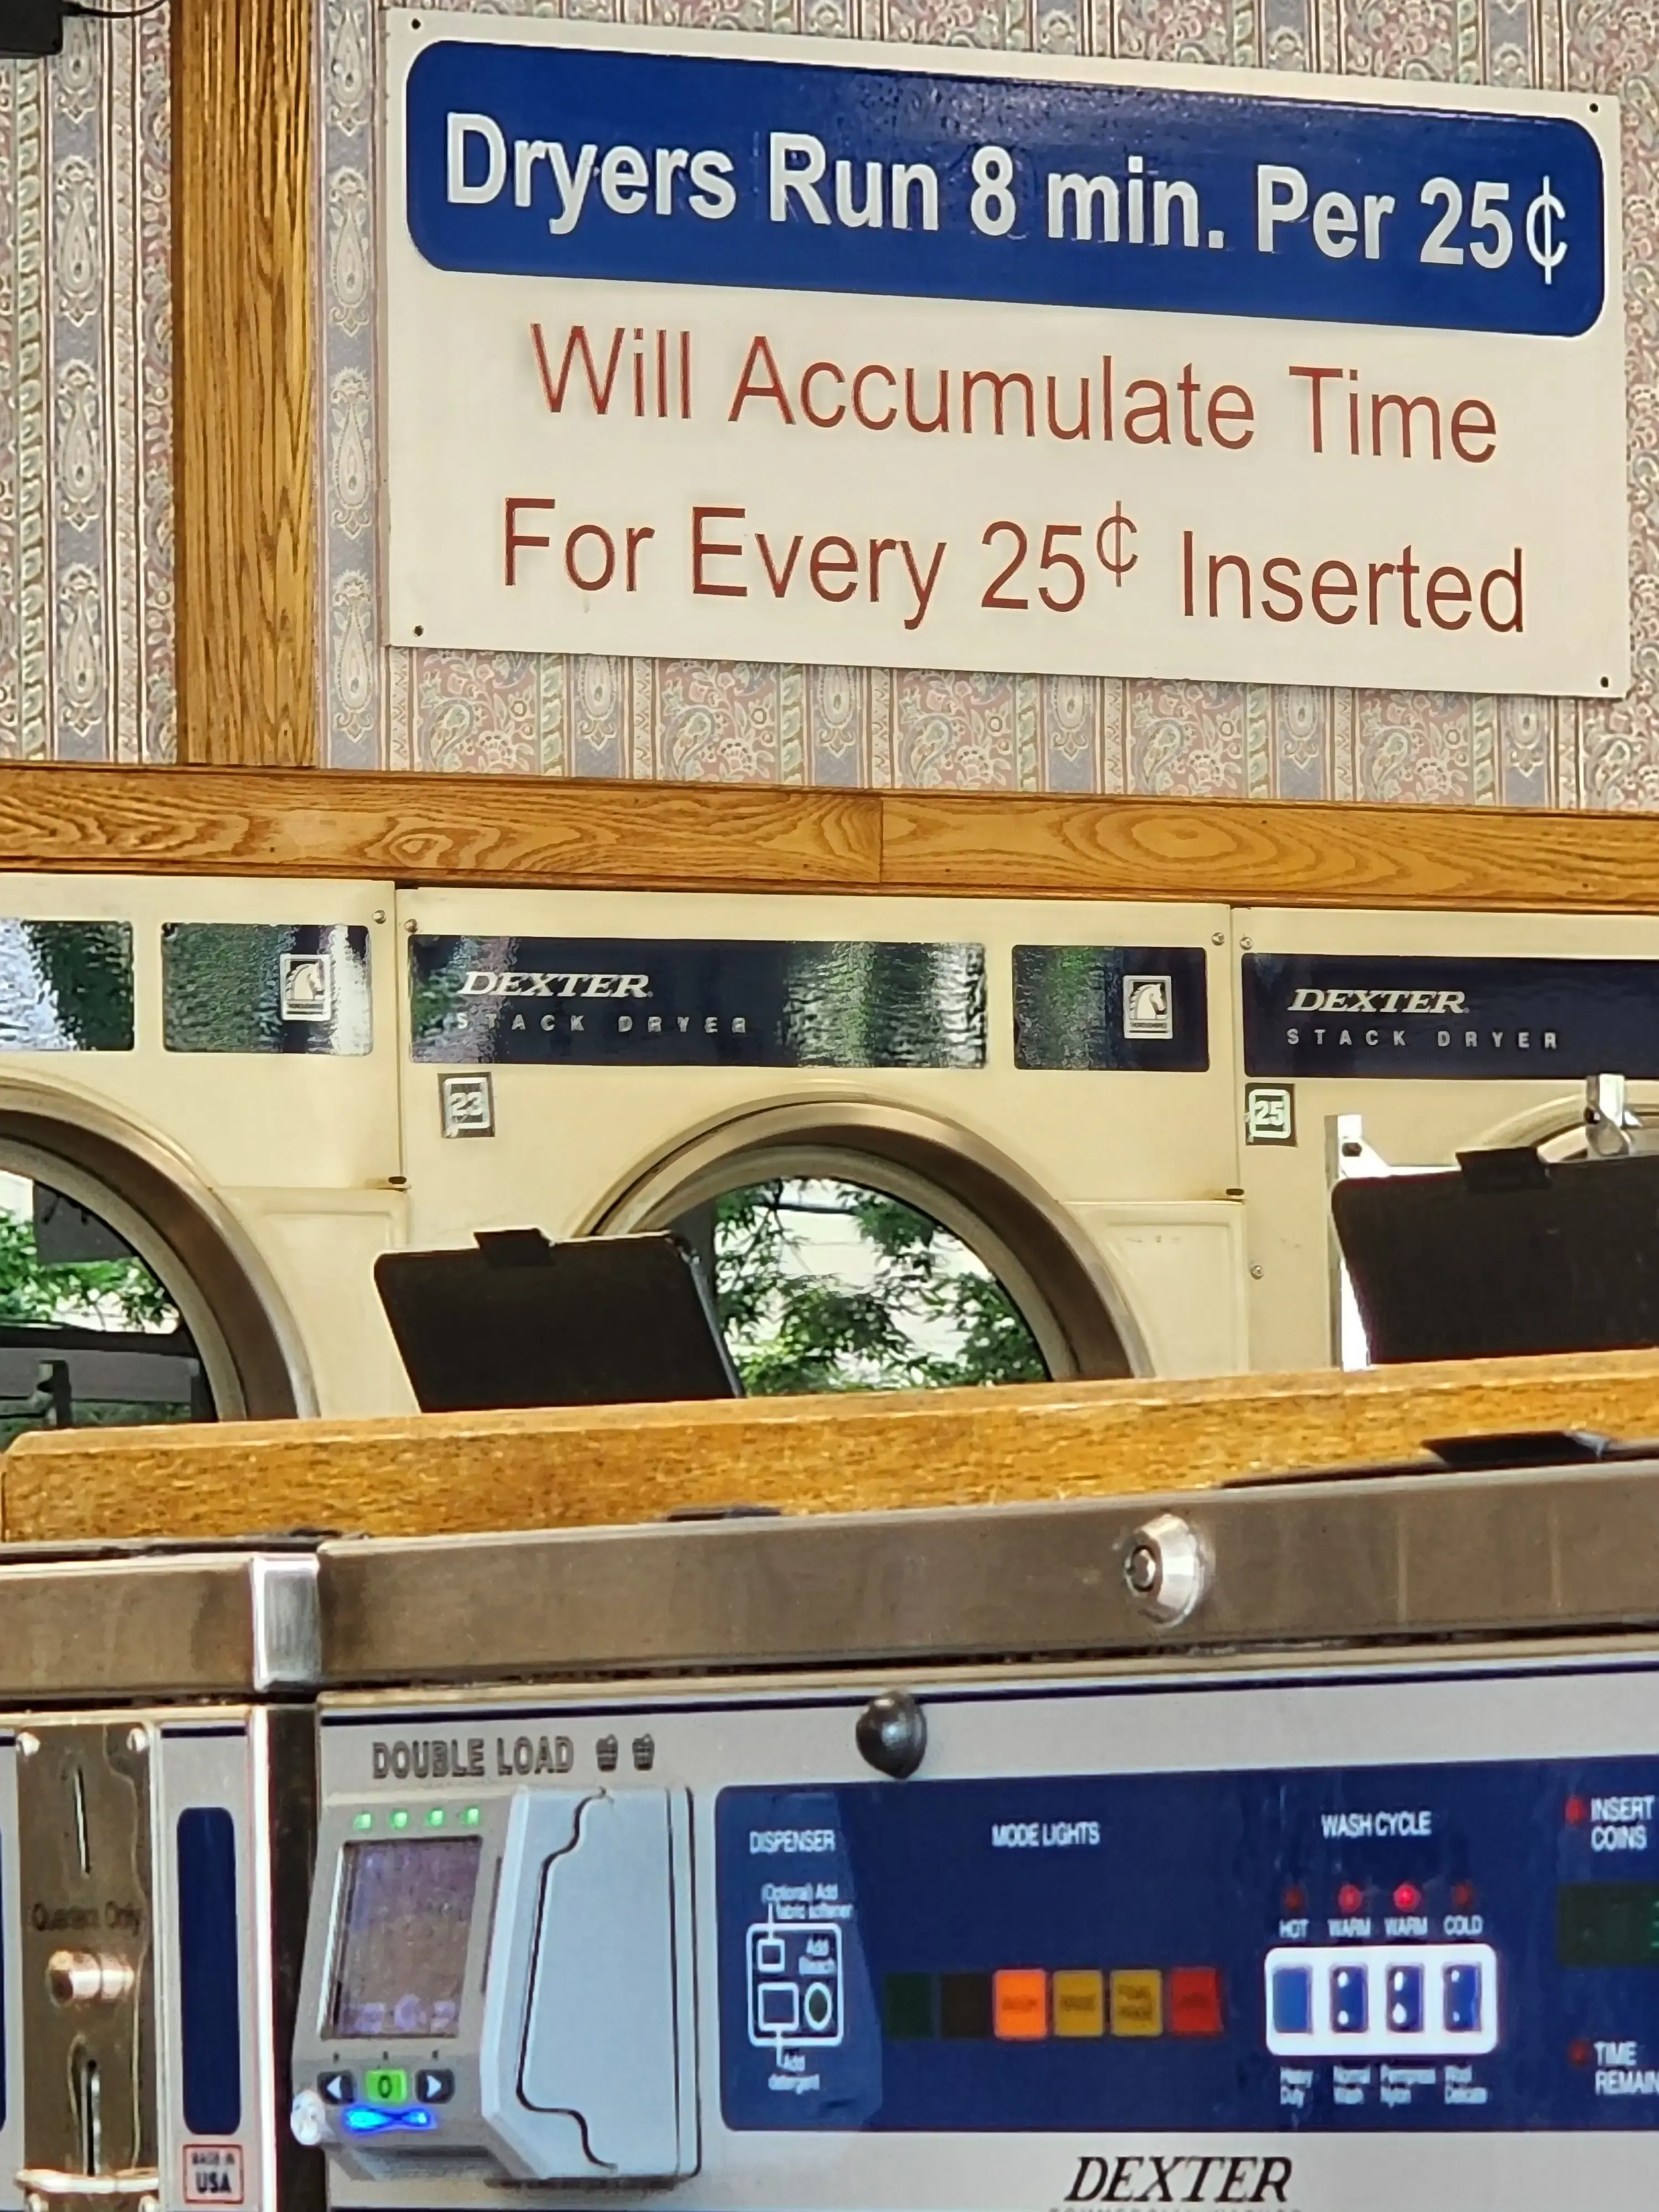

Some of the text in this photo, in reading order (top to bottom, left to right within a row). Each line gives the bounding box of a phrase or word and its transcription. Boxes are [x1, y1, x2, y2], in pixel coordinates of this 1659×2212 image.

[446, 111, 1567, 285] Dryers Run 8 min. Per 25¢
[530, 323, 1498, 463] Will Accumulate Time
[504, 497, 1524, 633] For Every 25¢ Inserted
[456, 971, 650, 998] DEXTER
[1287, 988, 1466, 1014] DEXTER
[456, 1013, 746, 1034] STACK DRYER
[1286, 1028, 1557, 1050] STACK DRYER
[450, 1091, 483, 1117] 23
[1254, 1100, 1284, 1126] 25
[373, 1735, 575, 1780] DOUBLE LOAD
[1590, 1795, 1655, 1823] INSERT
[992, 1820, 1101, 1848] MODE LIGHTS
[1321, 1810, 1433, 1839] WASH CYCLE
[749, 1829, 836, 1855] DISPENSER
[1591, 1824, 1647, 1853] COINS
[1279, 1918, 1310, 1939] HOT
[1327, 1917, 1371, 1939] WARM
[1384, 1916, 1428, 1938] WARM
[1443, 1914, 1484, 1937] COLD
[1593, 2041, 1638, 2067] TIME
[195, 2171, 232, 2194] USA
[1063, 2156, 1293, 2204] DEXTER
